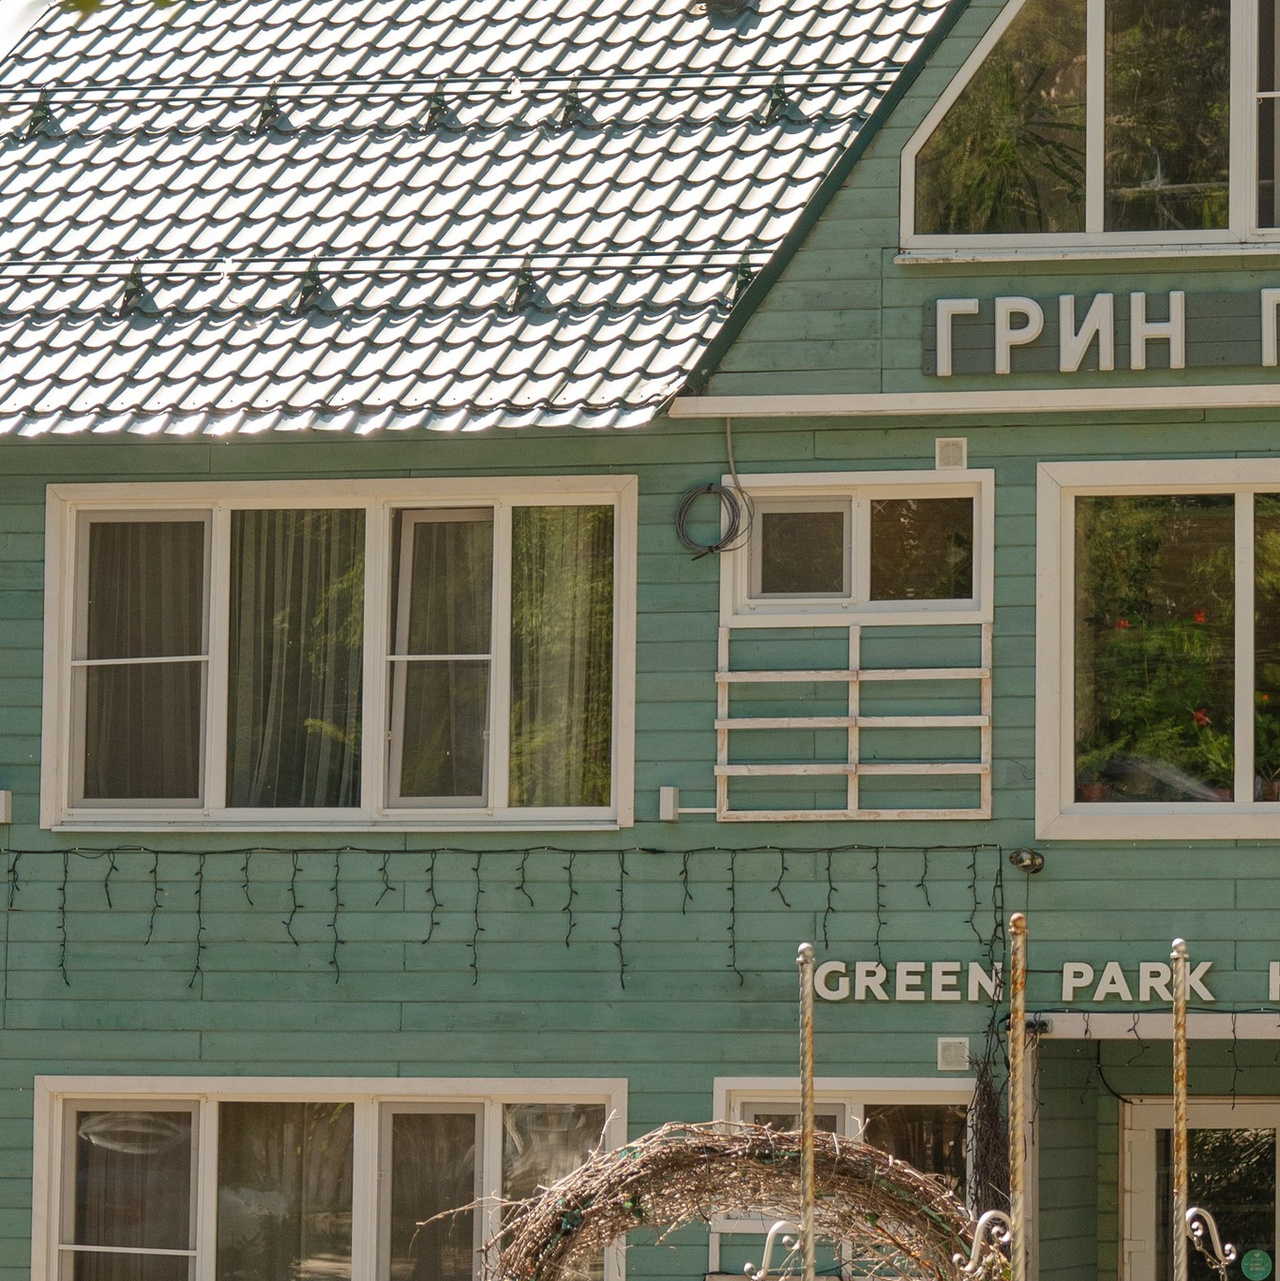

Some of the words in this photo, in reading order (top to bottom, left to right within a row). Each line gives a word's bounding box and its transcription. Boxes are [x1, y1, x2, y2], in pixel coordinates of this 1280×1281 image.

[935, 290, 1186, 376] ГРИН
[813, 960, 1003, 1002] GREEN
[1062, 961, 1216, 1002] PARK
